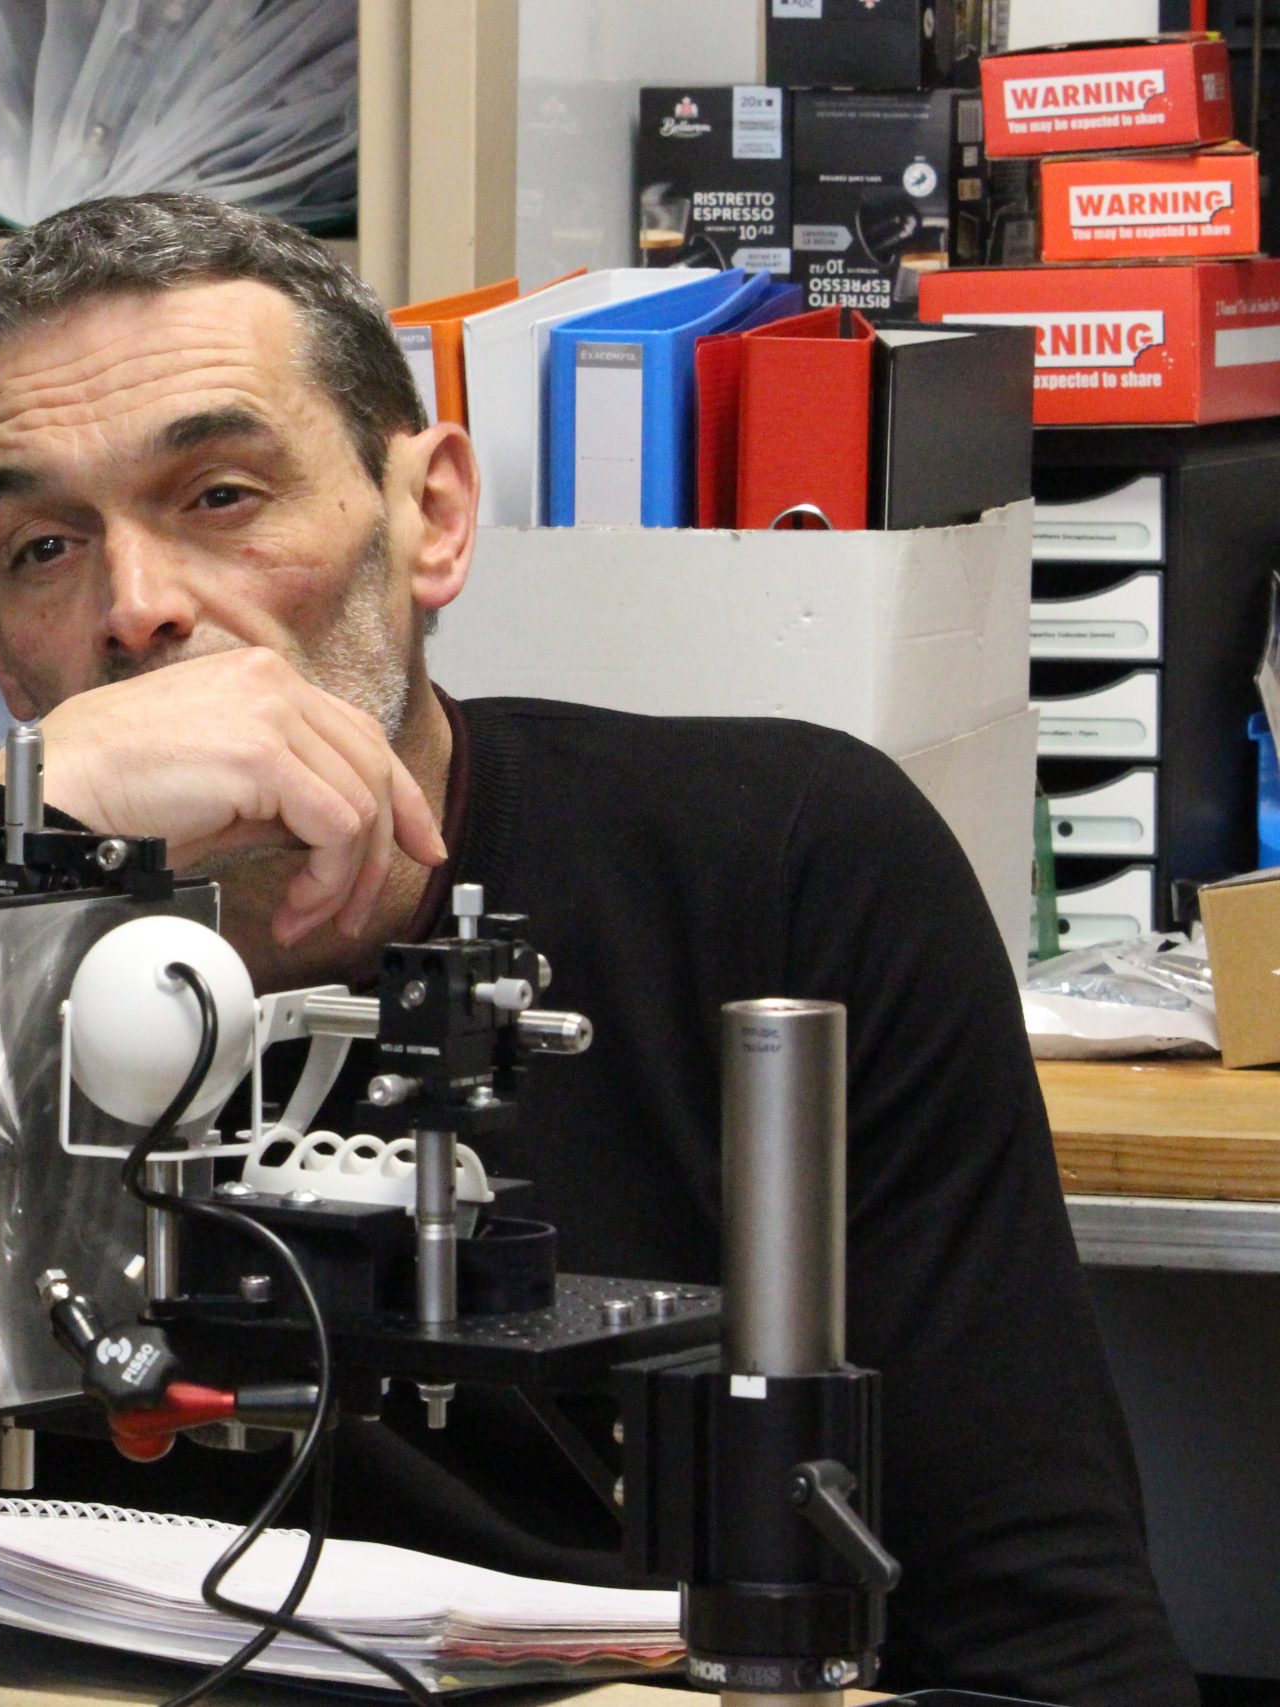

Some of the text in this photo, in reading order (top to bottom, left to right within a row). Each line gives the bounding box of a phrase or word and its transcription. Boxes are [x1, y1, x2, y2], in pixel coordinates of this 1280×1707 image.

[1010, 79, 1158, 111] WARNING
[1071, 115, 1119, 130] expected
[1122, 114, 1133, 126] to
[1135, 112, 1165, 125] share
[693, 192, 775, 206] RISTRETTO
[1076, 190, 1225, 217] WARNING
[693, 207, 775, 221] ESPRESSO
[738, 225, 758, 240] 10
[1187, 225, 1198, 236] to
[1200, 224, 1231, 236] share
[826, 259, 845, 274] 10
[809, 278, 891, 293] ESPRESSO
[808, 293, 891, 309] RISTRETTO
[1034, 371, 1162, 390] expected to share
[121, 1343, 154, 1384] FISSO
